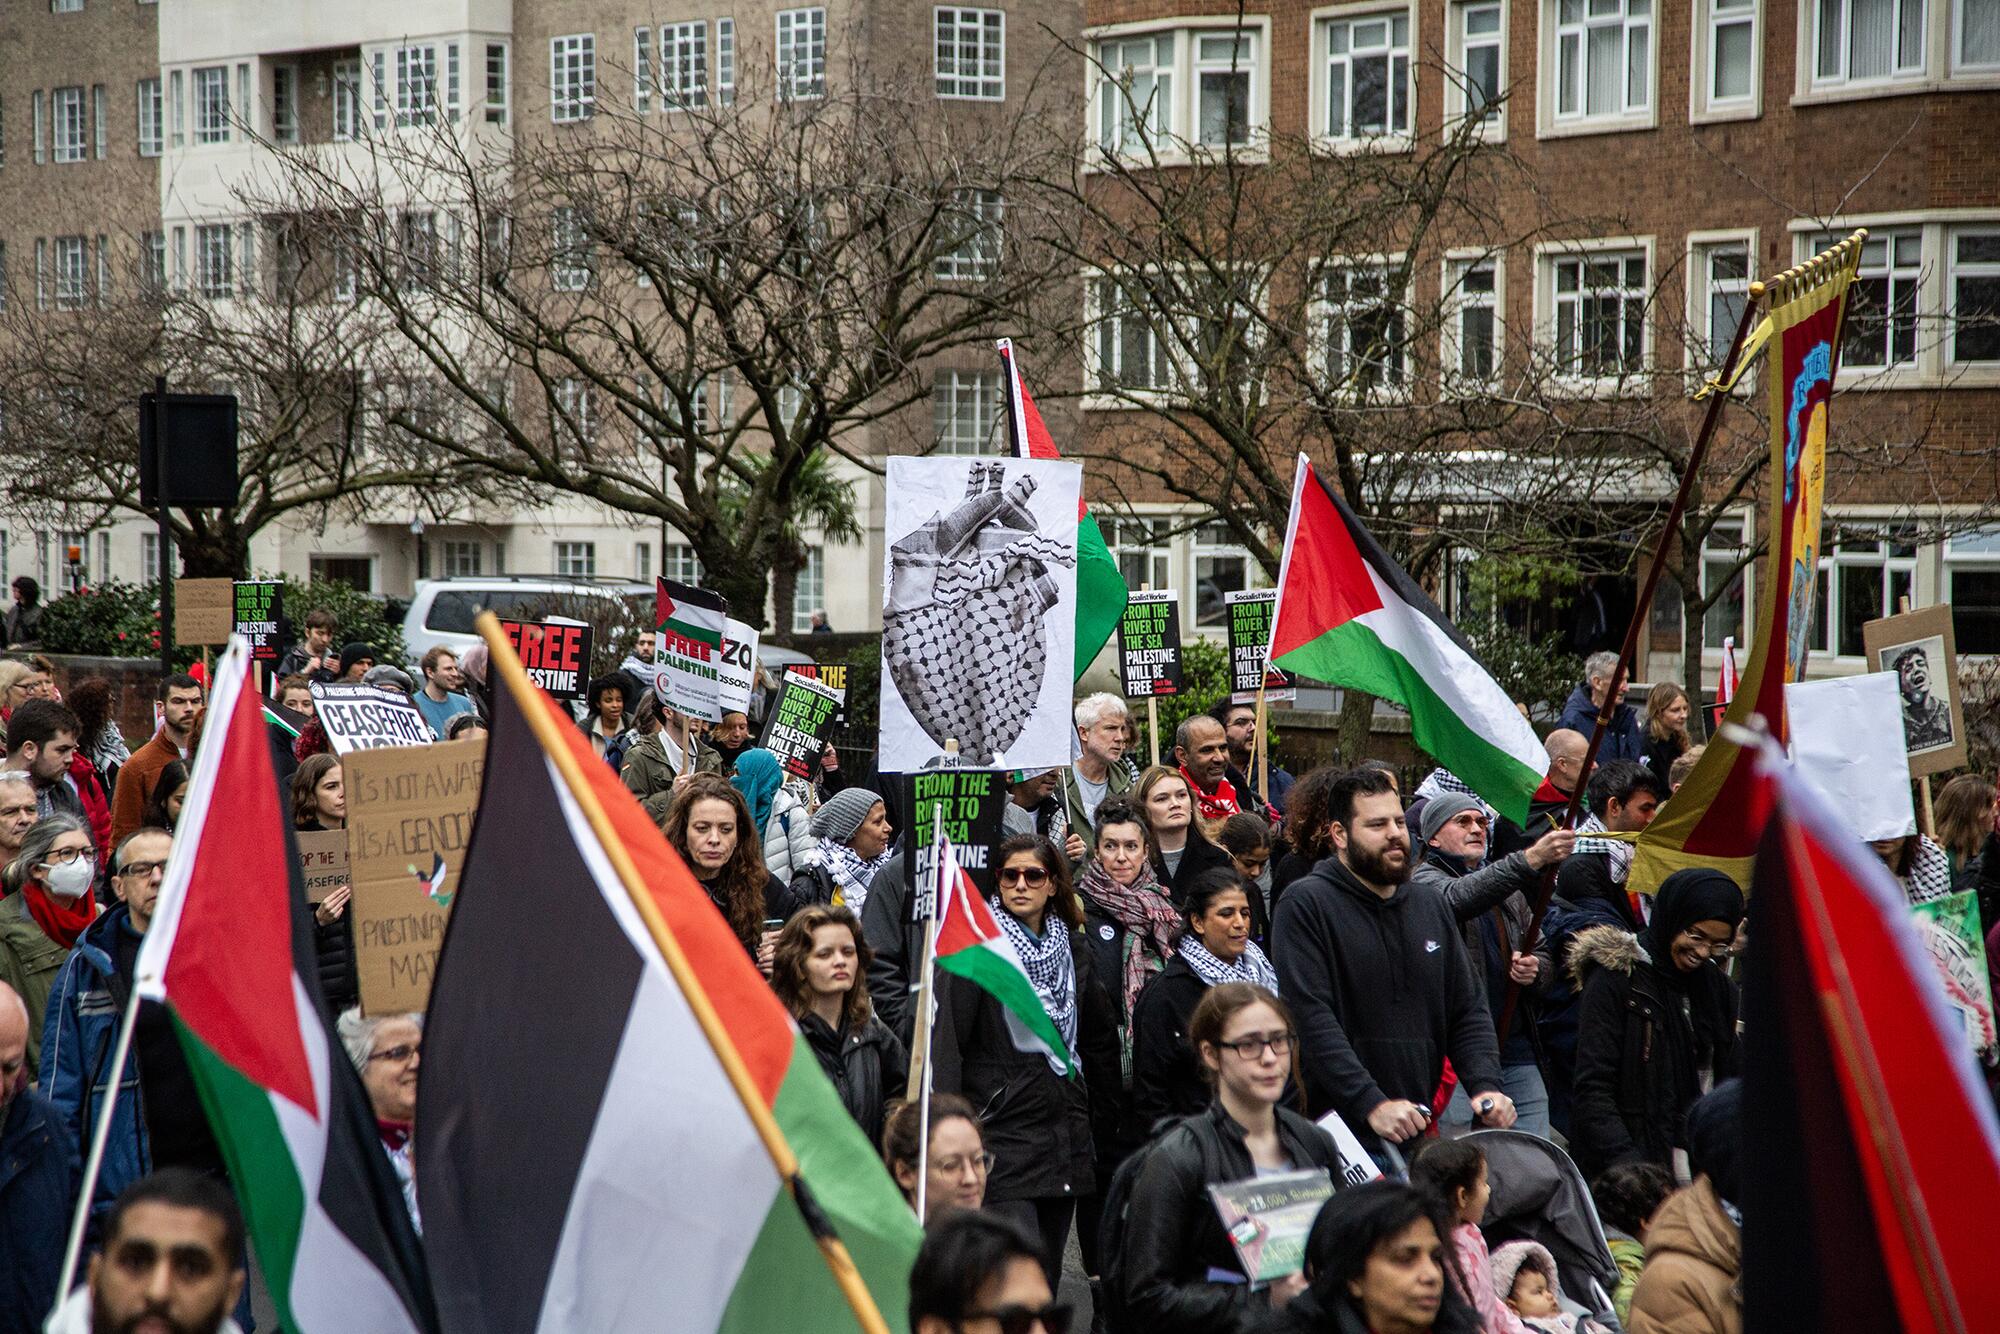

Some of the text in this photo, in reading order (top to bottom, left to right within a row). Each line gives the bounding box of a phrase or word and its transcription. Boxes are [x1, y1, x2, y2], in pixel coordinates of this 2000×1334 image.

[237, 584, 275, 596] FROM THE
[1129, 593, 1149, 601] ocialist
[1234, 592, 1260, 601] Socialist
[237, 597, 271, 609] RIVER TO
[1152, 603, 1170, 618] THE
[1232, 602, 1262, 618] FROM
[237, 609, 267, 621] THE SEA
[237, 621, 277, 634] PALESTINE
[1124, 618, 1166, 635] RIVER TO
[1233, 616, 1263, 632] RIVER
[255, 633, 267, 646] BE
[665, 629, 712, 663] FREE
[1124, 634, 1163, 650] THE SEA
[1234, 630, 1269, 647] THE SE
[1126, 648, 1176, 666] PALESTINE
[1235, 644, 1268, 661] PALES
[657, 650, 718, 681] PALESTINE
[1127, 664, 1165, 681] WILL BE
[1235, 660, 1261, 675] WILL
[820, 666, 847, 689] THE
[1236, 674, 1262, 690] FREE
[794, 676, 838, 698] Socialist Worker
[1128, 680, 1153, 696] FREE
[786, 684, 835, 714] FROM THE
[781, 697, 826, 724] RIVER TO
[322, 703, 429, 743] CEASEFIRE
[777, 710, 817, 735] THE SEA
[771, 722, 822, 753] PALESTINE
[767, 735, 807, 760] WILL BE
[385, 772, 418, 801] NOT
[425, 772, 440, 799] A
[915, 773, 992, 799] FROM THE
[958, 797, 979, 820] TO
[384, 829, 400, 858] A
[317, 851, 335, 865] THE
[304, 874, 350, 888] ASEFIRE
